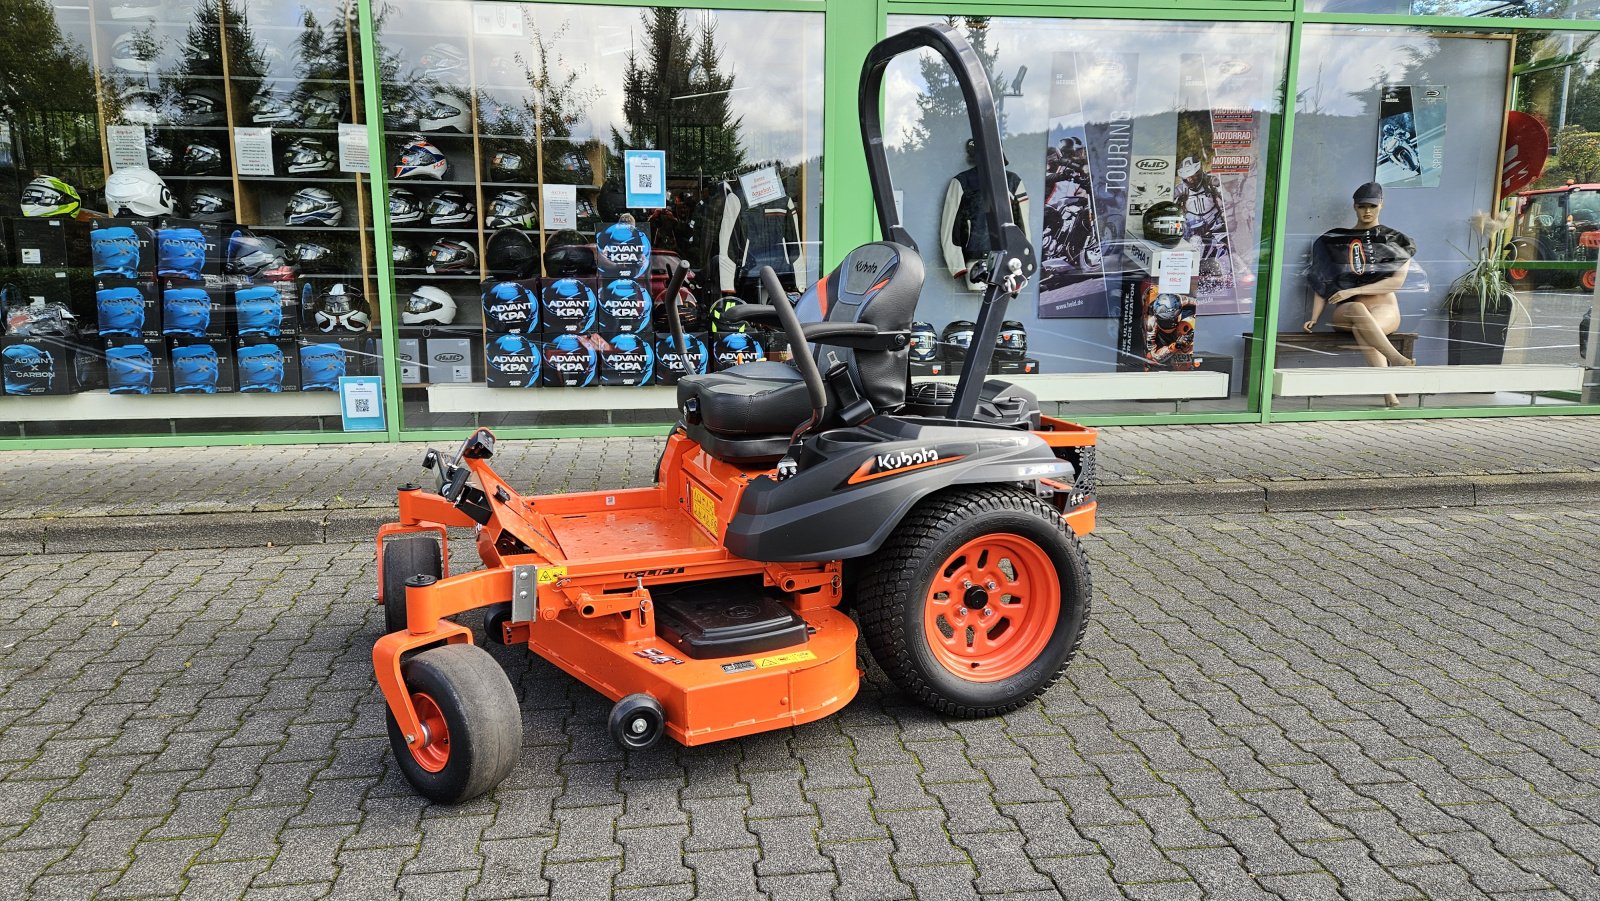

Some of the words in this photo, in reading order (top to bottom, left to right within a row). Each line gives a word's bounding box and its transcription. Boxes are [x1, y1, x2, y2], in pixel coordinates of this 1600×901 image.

[1214, 132, 1250, 140] MOTORRAD
[1105, 110, 1132, 192] TOURING
[1212, 156, 1249, 164] MOTORRAD
[1433, 146, 1442, 169] SPORT
[96, 239, 149, 248] ADVANT
[163, 238, 216, 251] ADVANT
[610, 253, 638, 262] KPA
[855, 260, 878, 274] Kubota
[489, 302, 533, 313] ADVANT
[1056, 300, 1083, 310] www.held.de
[498, 312, 526, 321] KPA
[556, 308, 584, 317] KPA
[612, 308, 639, 317] KPA
[500, 364, 528, 372] KPA
[557, 363, 584, 371] KPA
[614, 362, 642, 371] KPA
[878, 447, 938, 469] Kubota
[626, 567, 680, 579] K-LIFT
